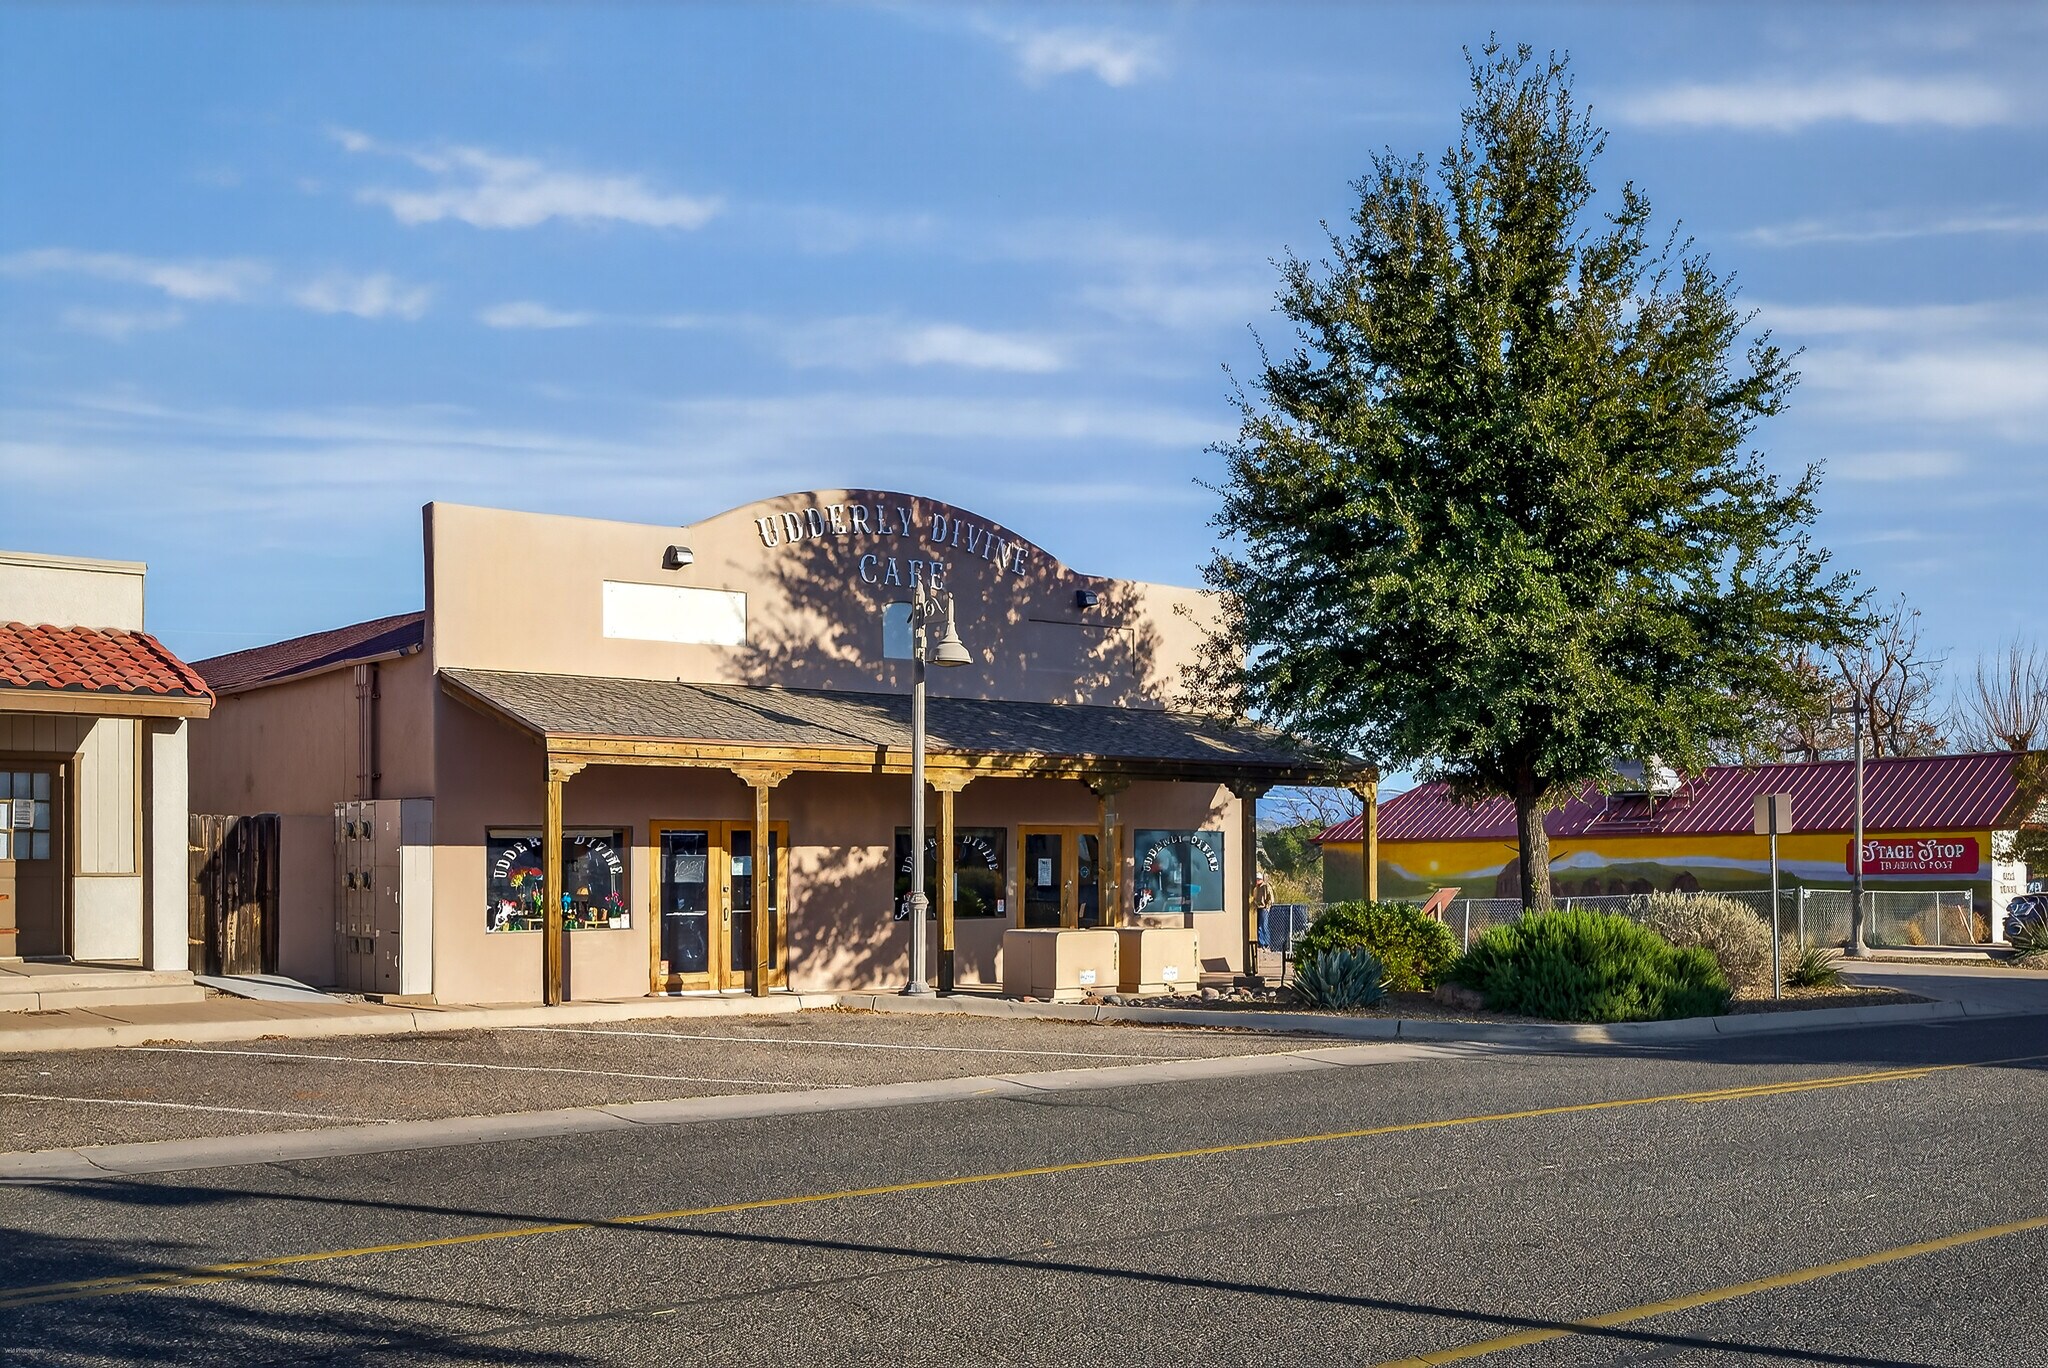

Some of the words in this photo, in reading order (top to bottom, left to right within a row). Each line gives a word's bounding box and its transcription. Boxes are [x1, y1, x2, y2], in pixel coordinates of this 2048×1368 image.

[755, 504, 913, 547] UDDERLY
[931, 513, 1029, 576] DIVINE
[859, 554, 944, 590] CAFE
[493, 836, 542, 879] UDDER
[574, 835, 623, 875] DIVINE
[963, 836, 999, 871] DIVINE
[1917, 839, 1965, 861] STOP
